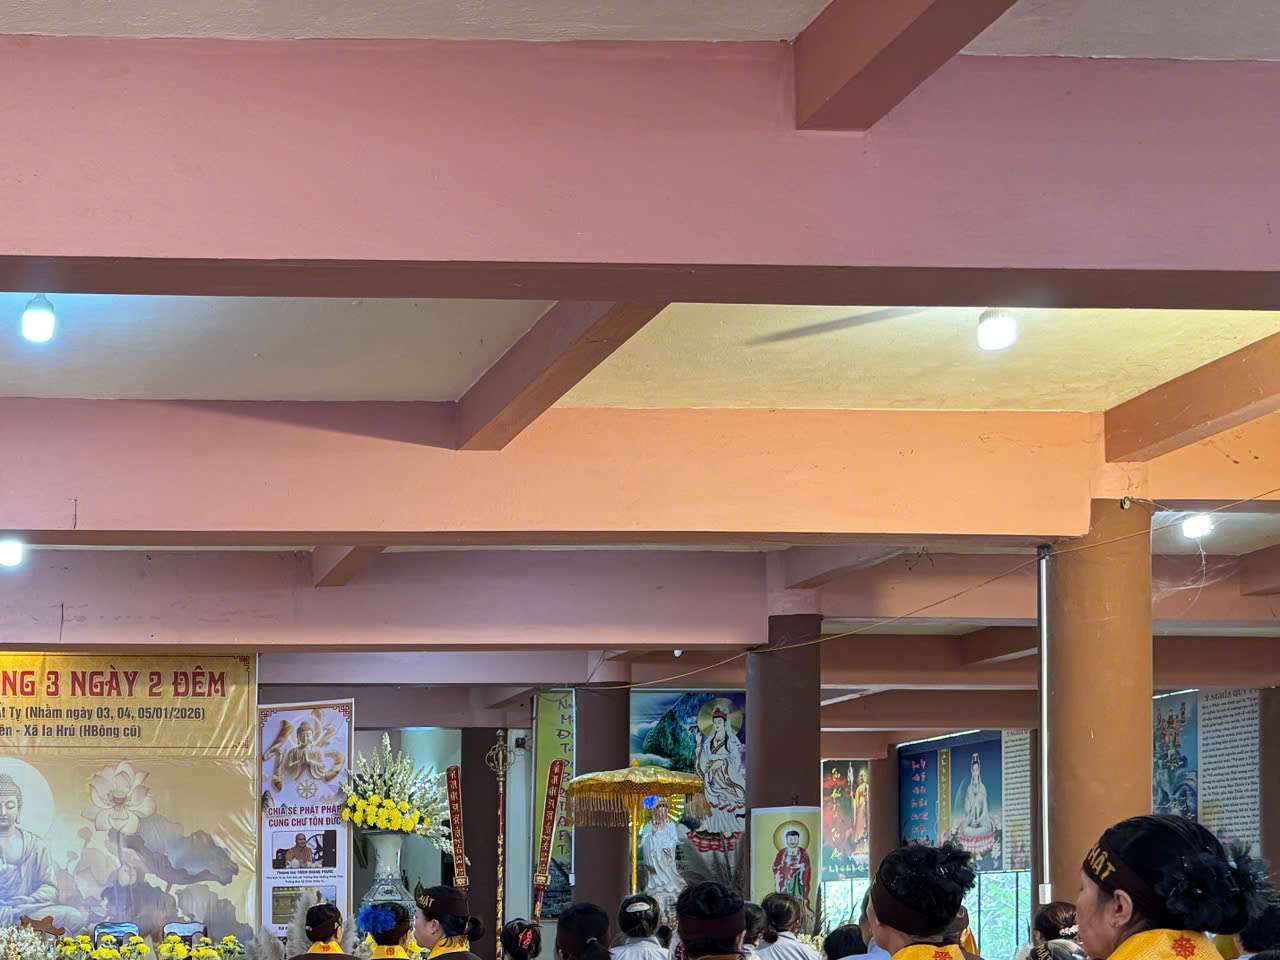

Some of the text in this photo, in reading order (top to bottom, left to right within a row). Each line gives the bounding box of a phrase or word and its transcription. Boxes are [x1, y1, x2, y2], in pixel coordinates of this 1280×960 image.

[46, 670, 59, 697] 3
[70, 665, 139, 697] NGÀY
[148, 671, 162, 697] 2
[172, 665, 226, 698] ĐÊM
[25, 704, 62, 719] (Nhằm
[66, 706, 93, 720] ngày
[96, 707, 114, 720] 03,
[117, 707, 135, 720] 04,
[138, 707, 205, 721] 05/01/2026)
[24, 724, 38, 737] Xã
[56, 724, 75, 737] Hrú
[79, 724, 119, 739] (HBông
[123, 724, 141, 739] cũ)
[1088, 843, 1117, 881] HẬT
